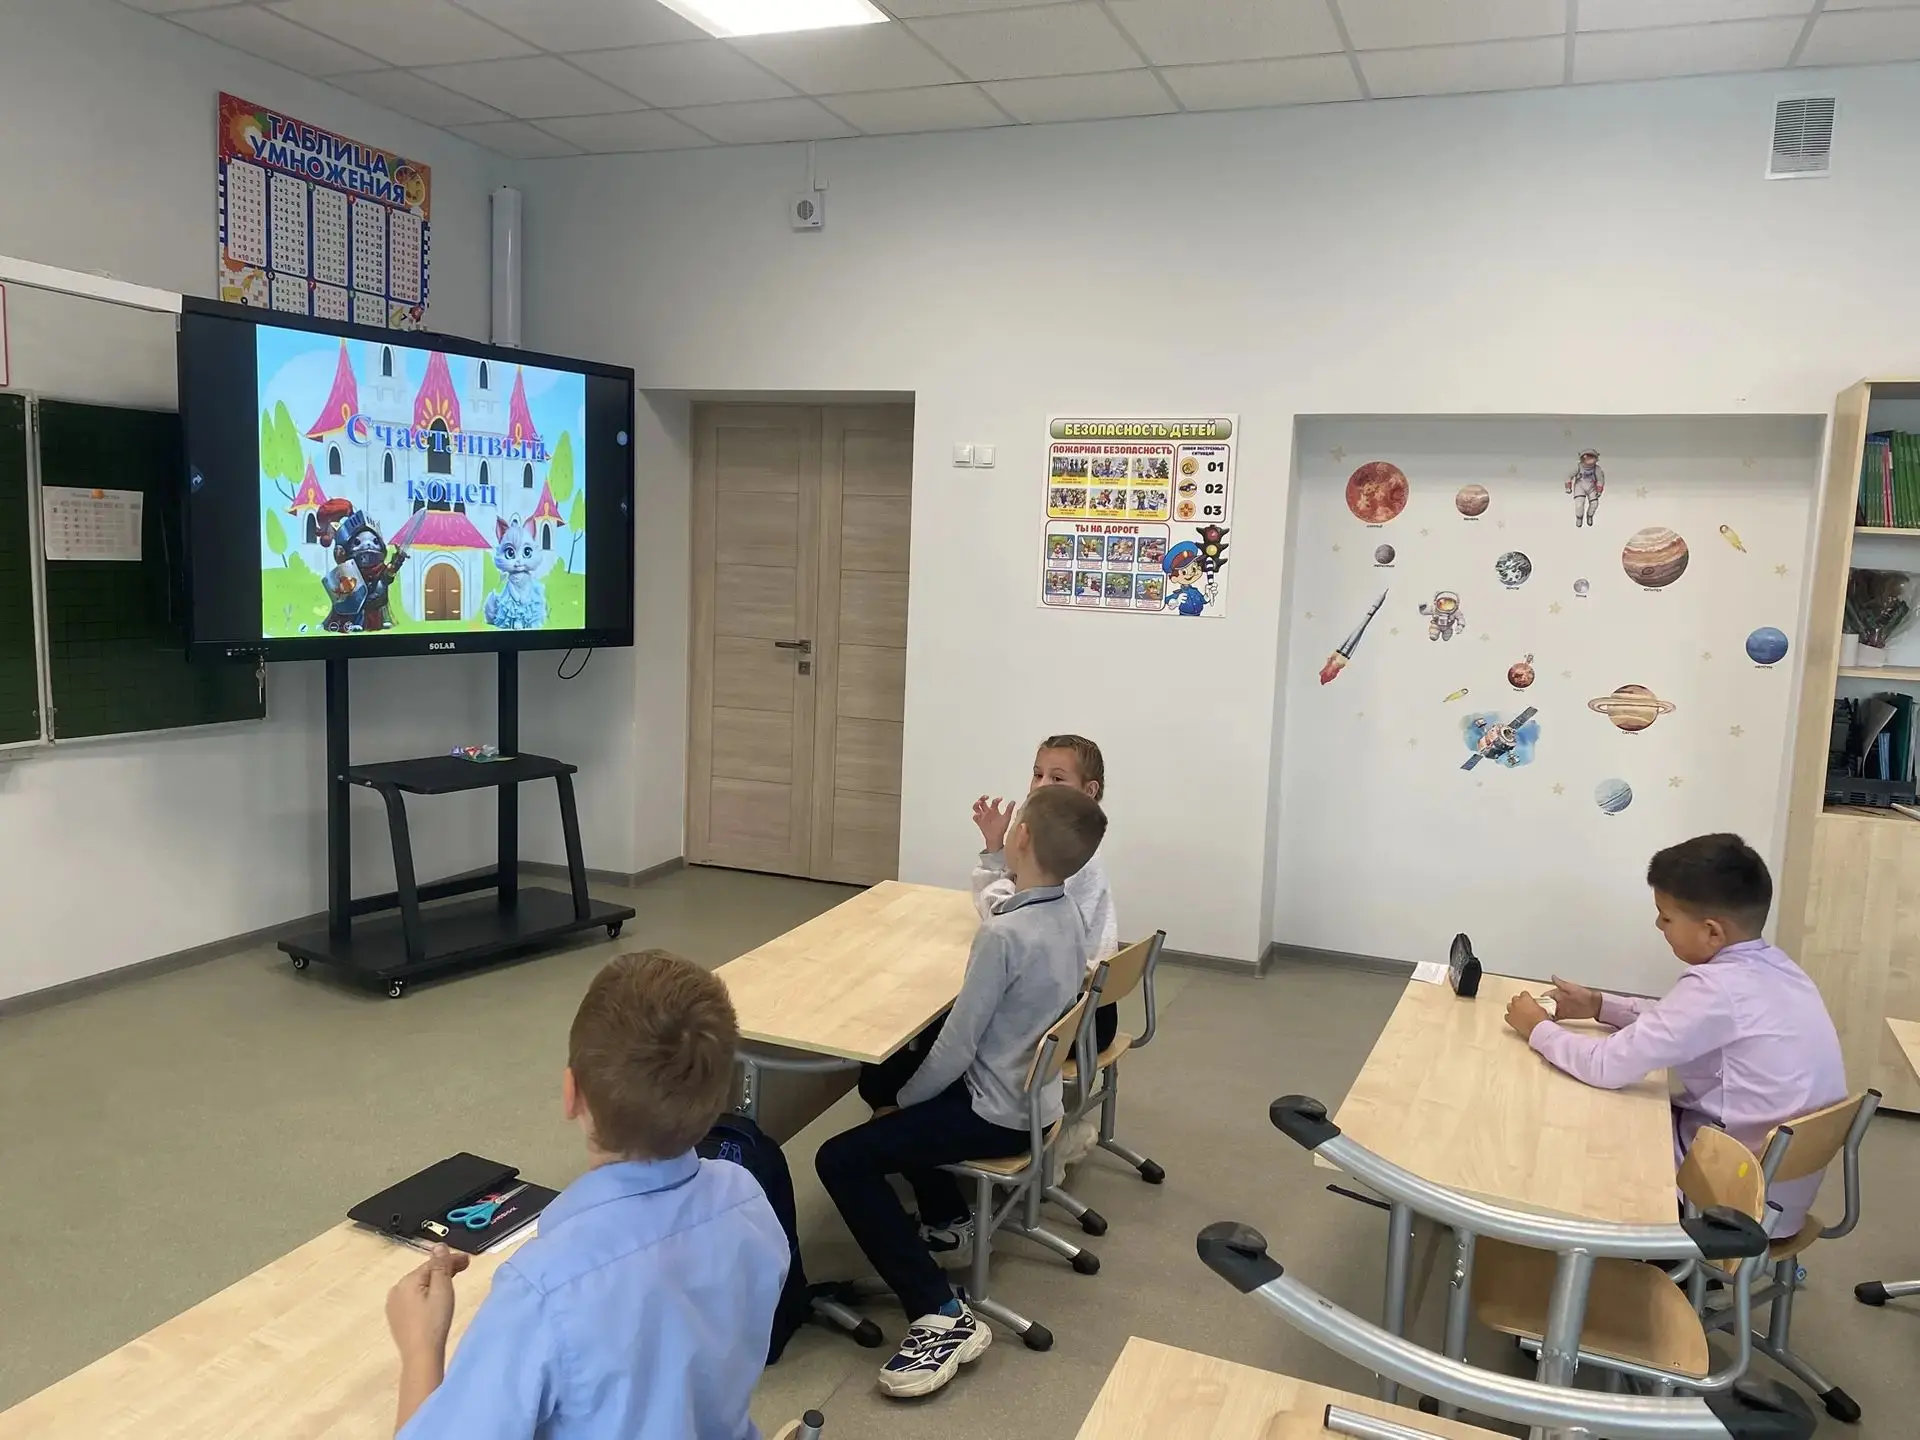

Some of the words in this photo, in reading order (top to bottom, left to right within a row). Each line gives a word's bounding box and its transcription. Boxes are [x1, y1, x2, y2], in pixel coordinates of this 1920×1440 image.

[267, 114, 390, 177] ТАБЛИЦА
[249, 135, 406, 205] УМНОЖЕНИЯ
[1064, 423, 1168, 436] БЕЗОПАСНОСТЬ
[1170, 419, 1216, 438] ДЕТЕЙ
[346, 414, 547, 462] Счастливый
[1053, 446, 1102, 454] ПОЖАРНАЯ
[1104, 446, 1172, 454] БЕЗОПАСНОСТЬ
[1208, 462, 1224, 472] 01
[407, 477, 498, 506] конец
[1205, 484, 1223, 494] 02
[1204, 505, 1222, 515] 03
[1075, 524, 1089, 532] ТЫ
[1104, 526, 1139, 534] ДОРОГЕ
